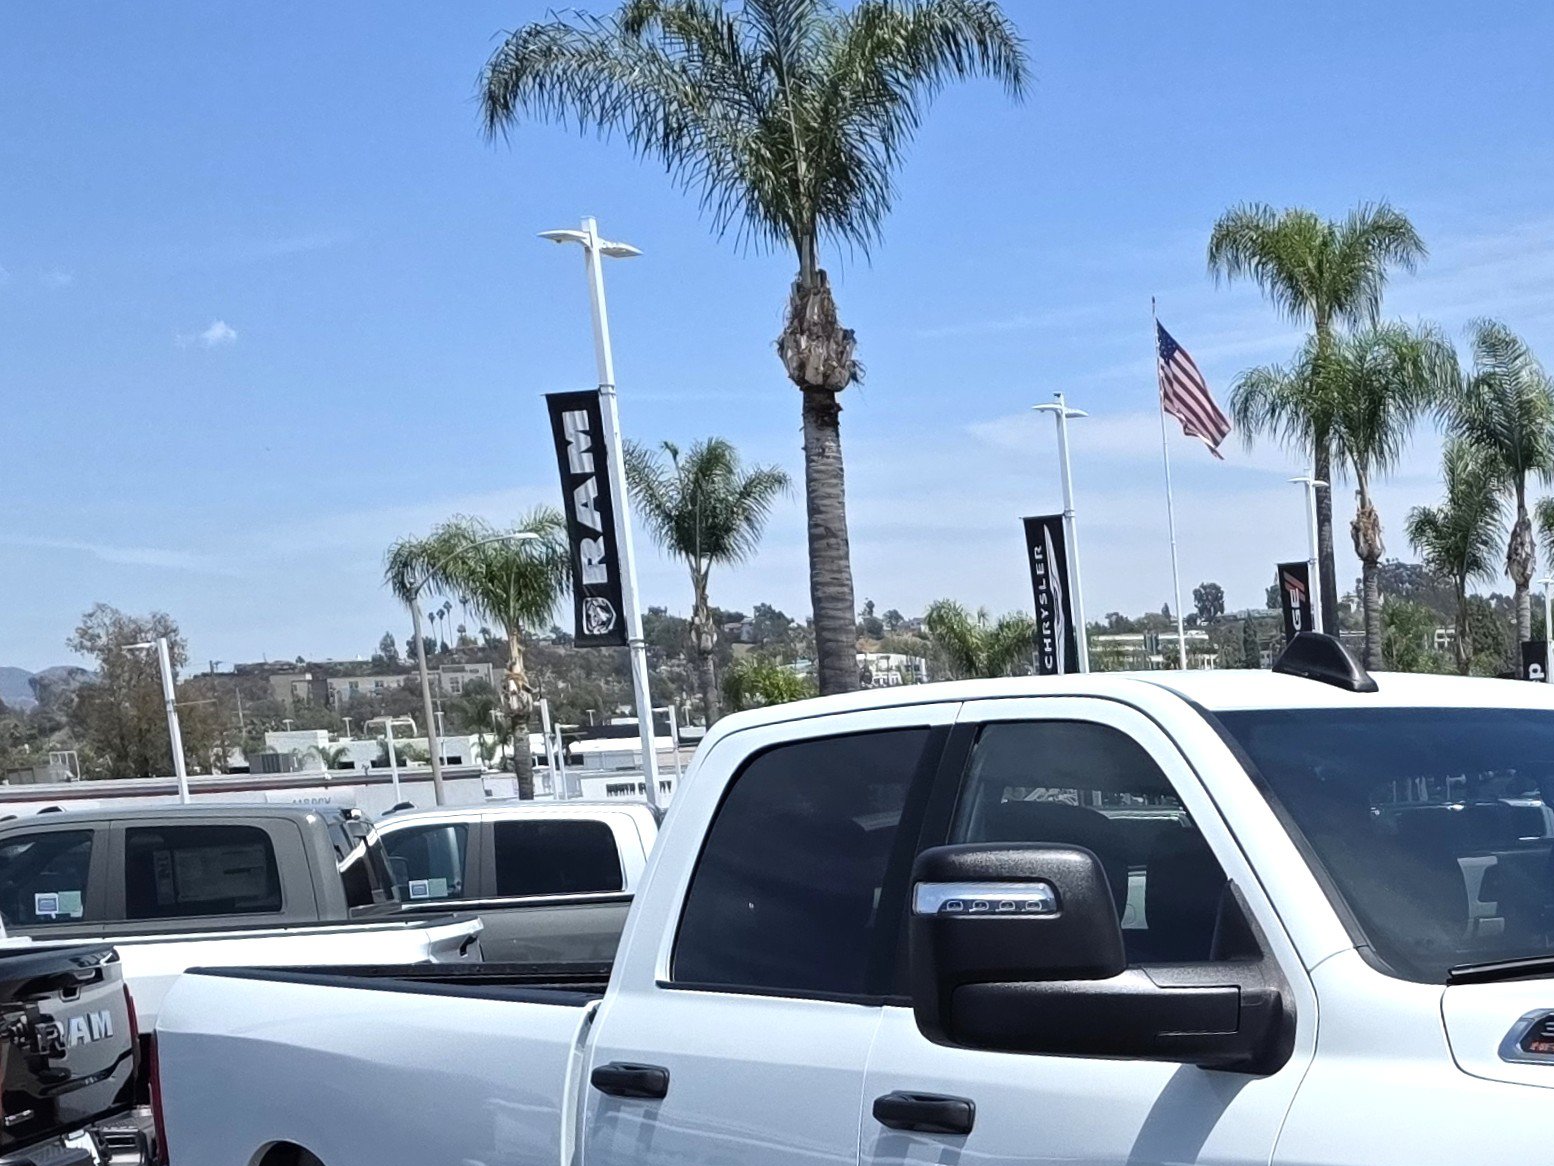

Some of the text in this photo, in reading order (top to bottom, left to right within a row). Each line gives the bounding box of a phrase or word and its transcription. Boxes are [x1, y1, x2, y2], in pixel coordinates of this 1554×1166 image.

[561, 409, 608, 585] RAM
[1034, 545, 1054, 670] CHRYSLER
[37, 1008, 114, 1060] RAM
